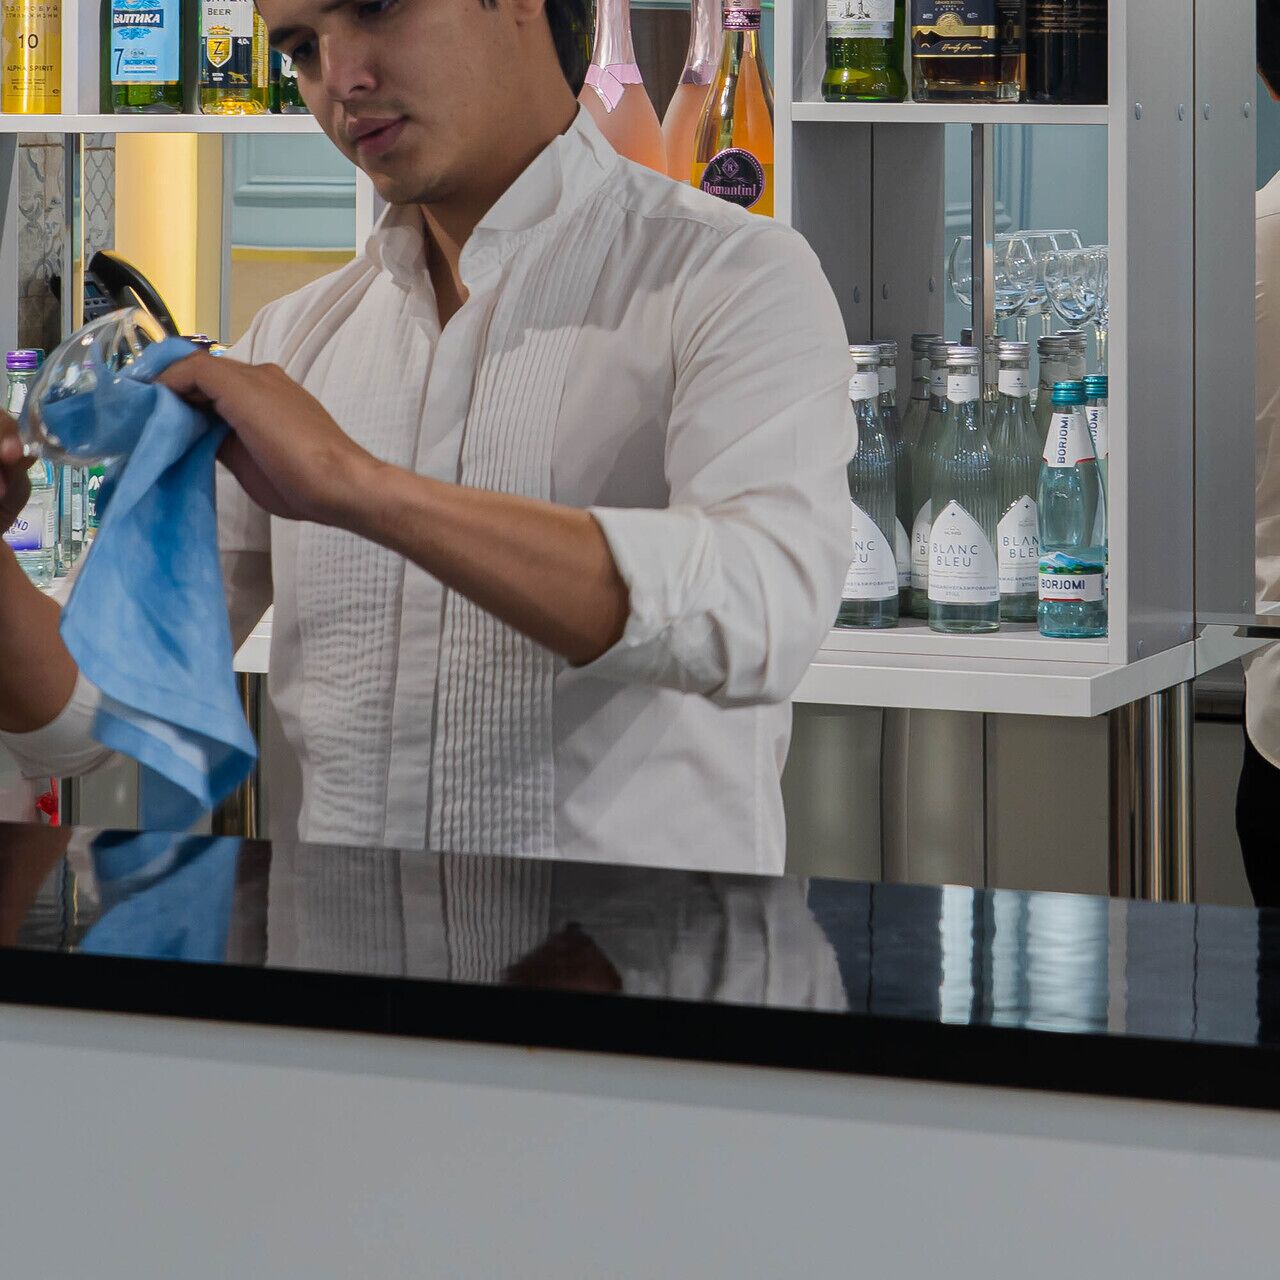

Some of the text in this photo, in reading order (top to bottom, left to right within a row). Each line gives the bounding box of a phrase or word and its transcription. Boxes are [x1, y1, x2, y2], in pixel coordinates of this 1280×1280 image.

[207, 8, 232, 16] BEER
[113, 13, 161, 24] БАЛТИКА
[18, 33, 39, 49] 10
[213, 41, 223, 55] Z
[114, 48, 125, 75] 7
[29, 64, 54, 72] SPIRIT
[703, 181, 757, 196] Romantini
[1057, 416, 1069, 464] BORJOMI
[1003, 536, 1039, 547] BLAN
[933, 543, 979, 556] BLANC
[936, 555, 972, 567] BLEU
[1041, 579, 1086, 590] BORJOMI
